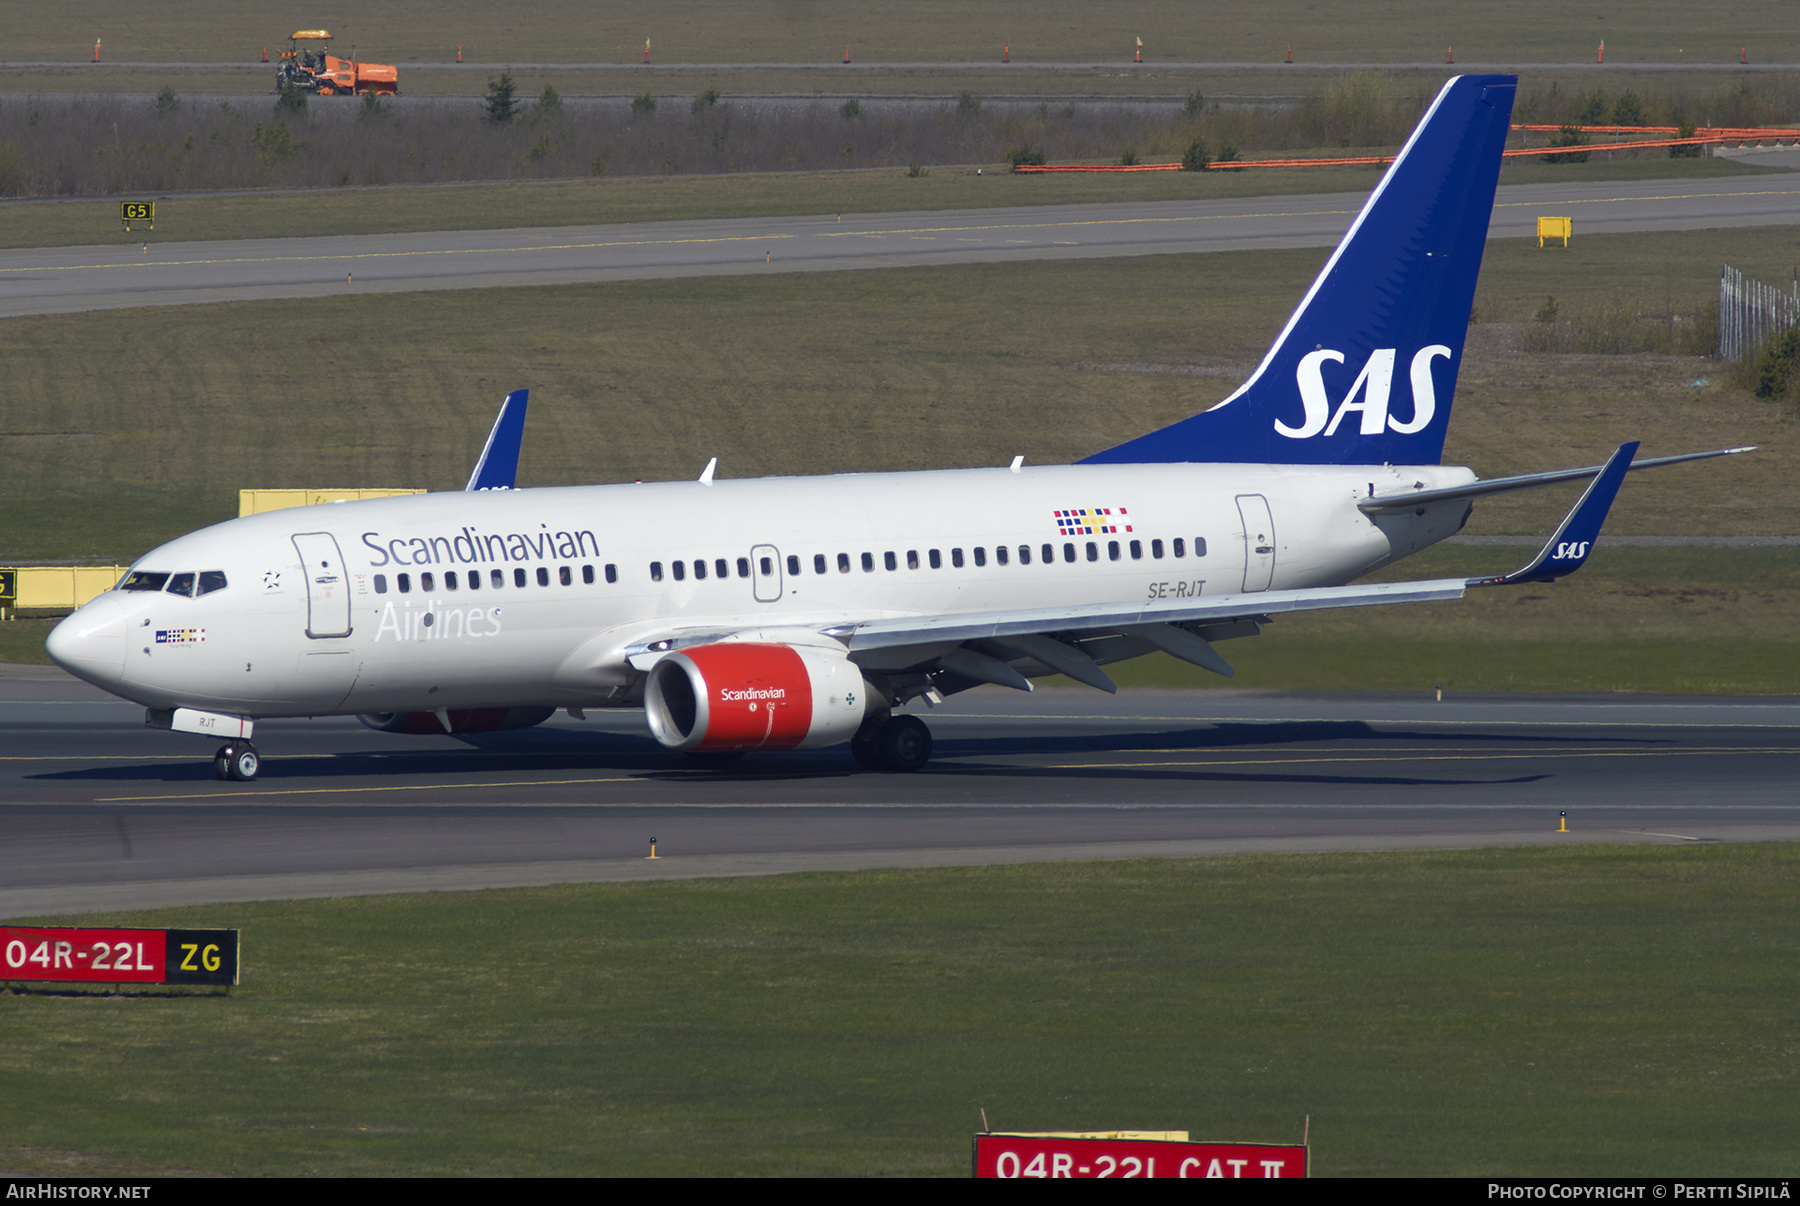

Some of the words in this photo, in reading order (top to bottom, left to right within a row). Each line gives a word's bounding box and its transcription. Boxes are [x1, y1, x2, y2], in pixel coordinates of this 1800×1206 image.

[127, 205, 147, 218] G5
[1274, 344, 1452, 439] SAS
[361, 523, 600, 567] Scandinavian
[1552, 541, 1590, 560] SAS
[1148, 580, 1206, 599] SE-RJT
[374, 599, 502, 643] Airlines
[721, 686, 785, 701] Scandinavian
[199, 717, 216, 728] RJT
[5, 939, 154, 971] 04R-22L
[180, 943, 221, 972] ZG
[1179, 1157, 1248, 1178] CAT
